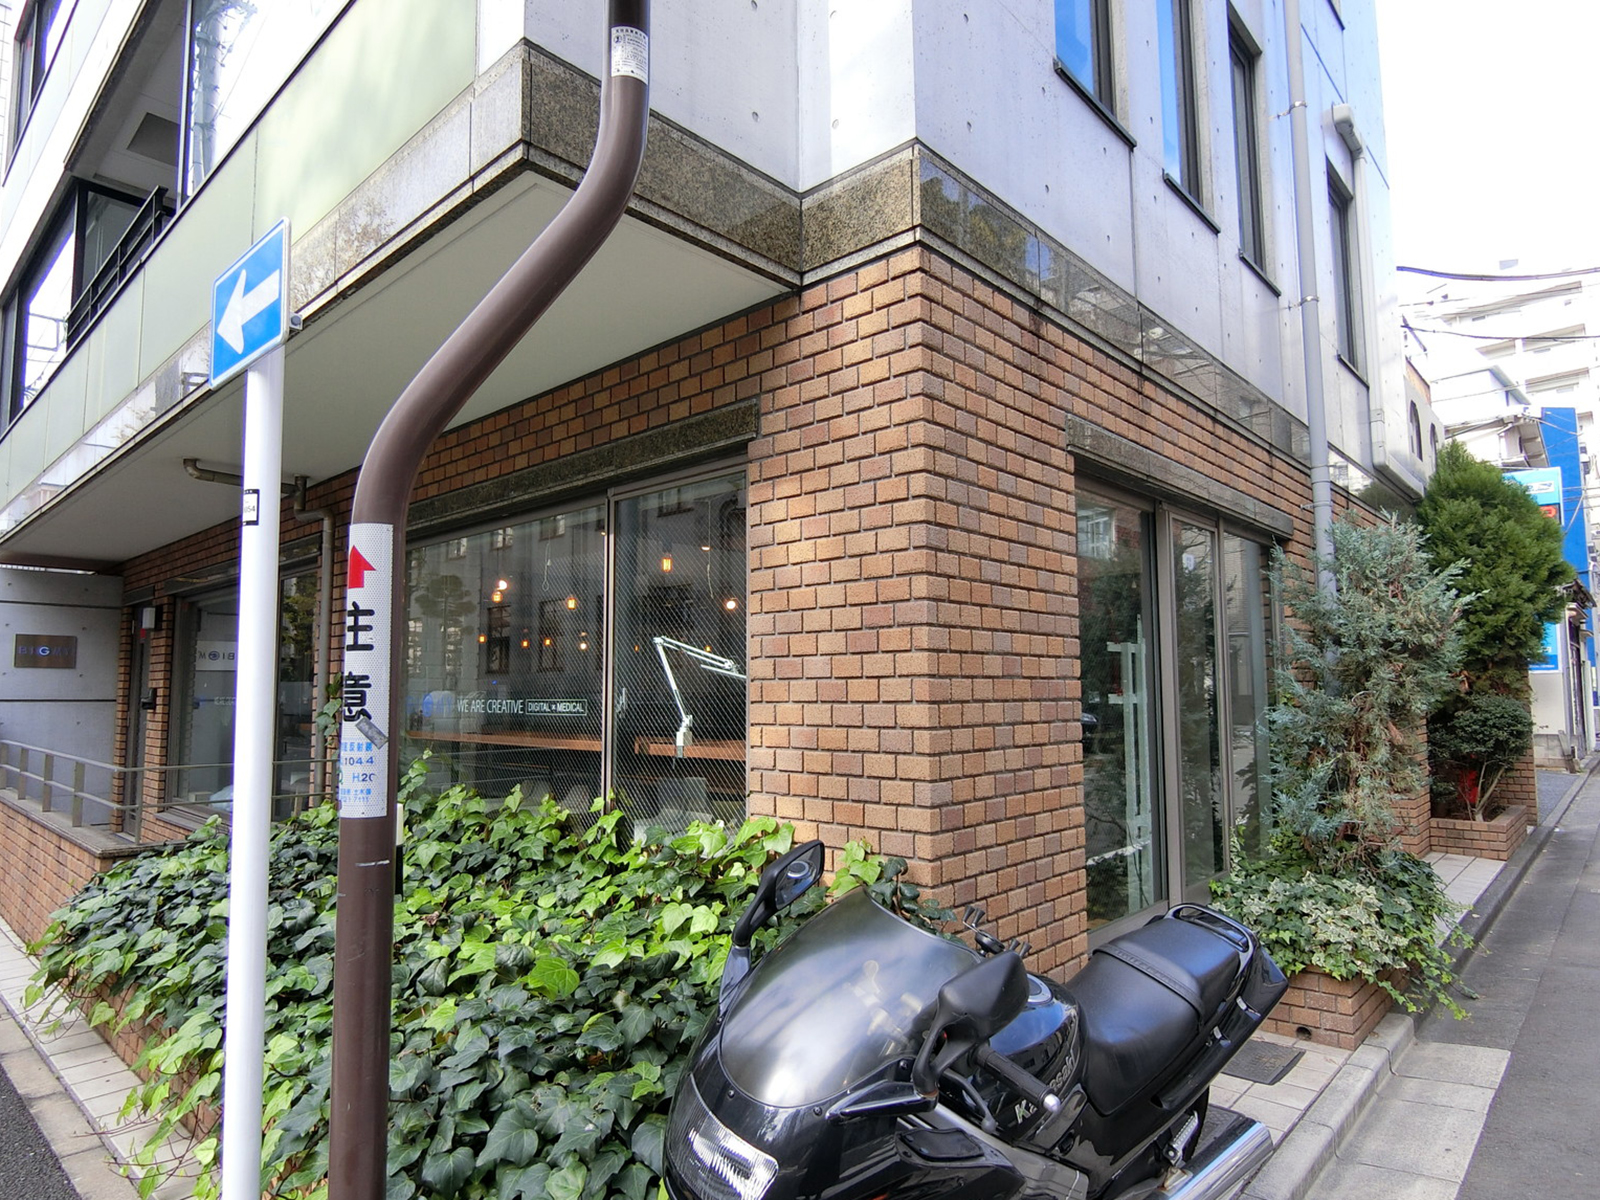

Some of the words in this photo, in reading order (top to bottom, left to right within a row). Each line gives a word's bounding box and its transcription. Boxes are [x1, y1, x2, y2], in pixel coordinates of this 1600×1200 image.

[457, 698, 469, 713] WE
[470, 699, 485, 713] ARE
[486, 699, 524, 714] CREATIVE
[528, 702, 550, 712] DIGITAL
[557, 703, 584, 712] MEDICAL
